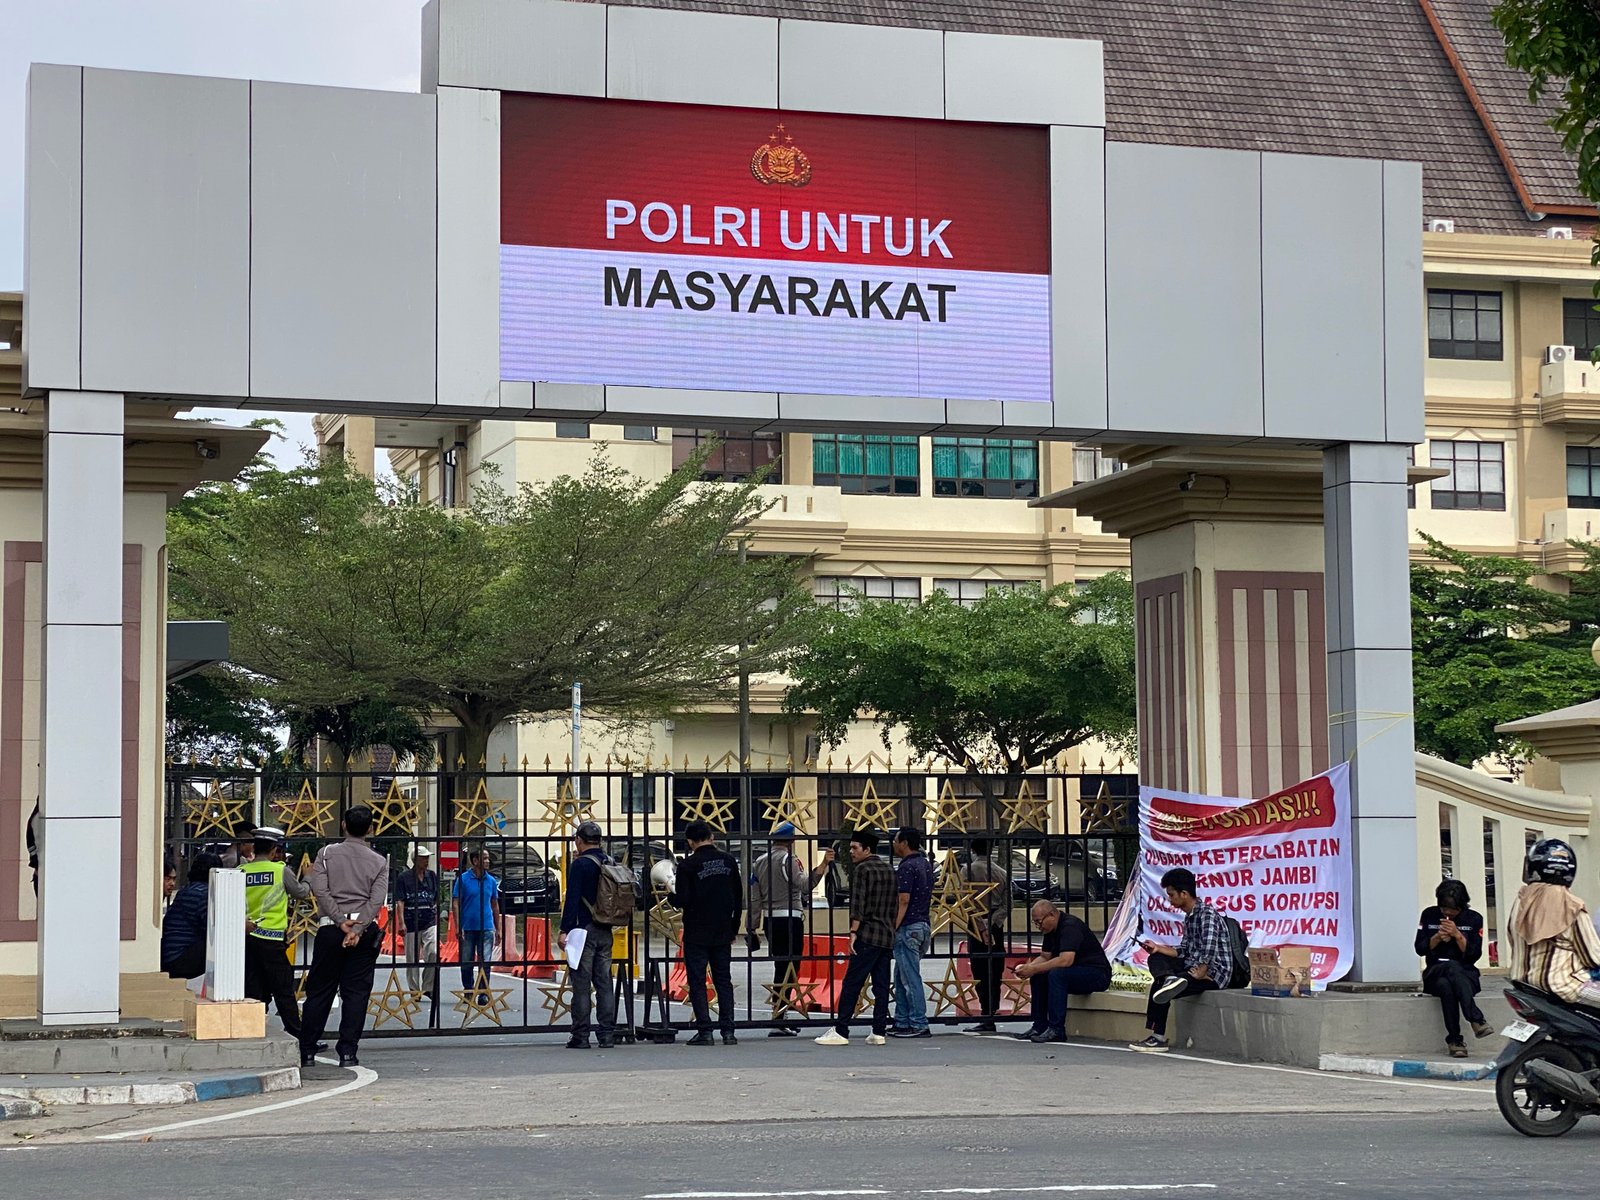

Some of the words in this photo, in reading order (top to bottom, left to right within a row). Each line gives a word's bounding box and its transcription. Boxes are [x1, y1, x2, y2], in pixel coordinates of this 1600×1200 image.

[605, 199, 761, 248] POLRI
[779, 209, 955, 260] UNTUK
[603, 266, 957, 323] MASYARAKAT
[1145, 850, 1193, 867] DUGAAN
[1198, 838, 1341, 866] KETERLIBATAN
[246, 873, 273, 885] OLISI
[1260, 866, 1317, 885] JAMBI
[1203, 894, 1256, 913] ASUS
[1262, 891, 1339, 912] KORUPSI
[1241, 917, 1338, 937] ENDIDIKAN
